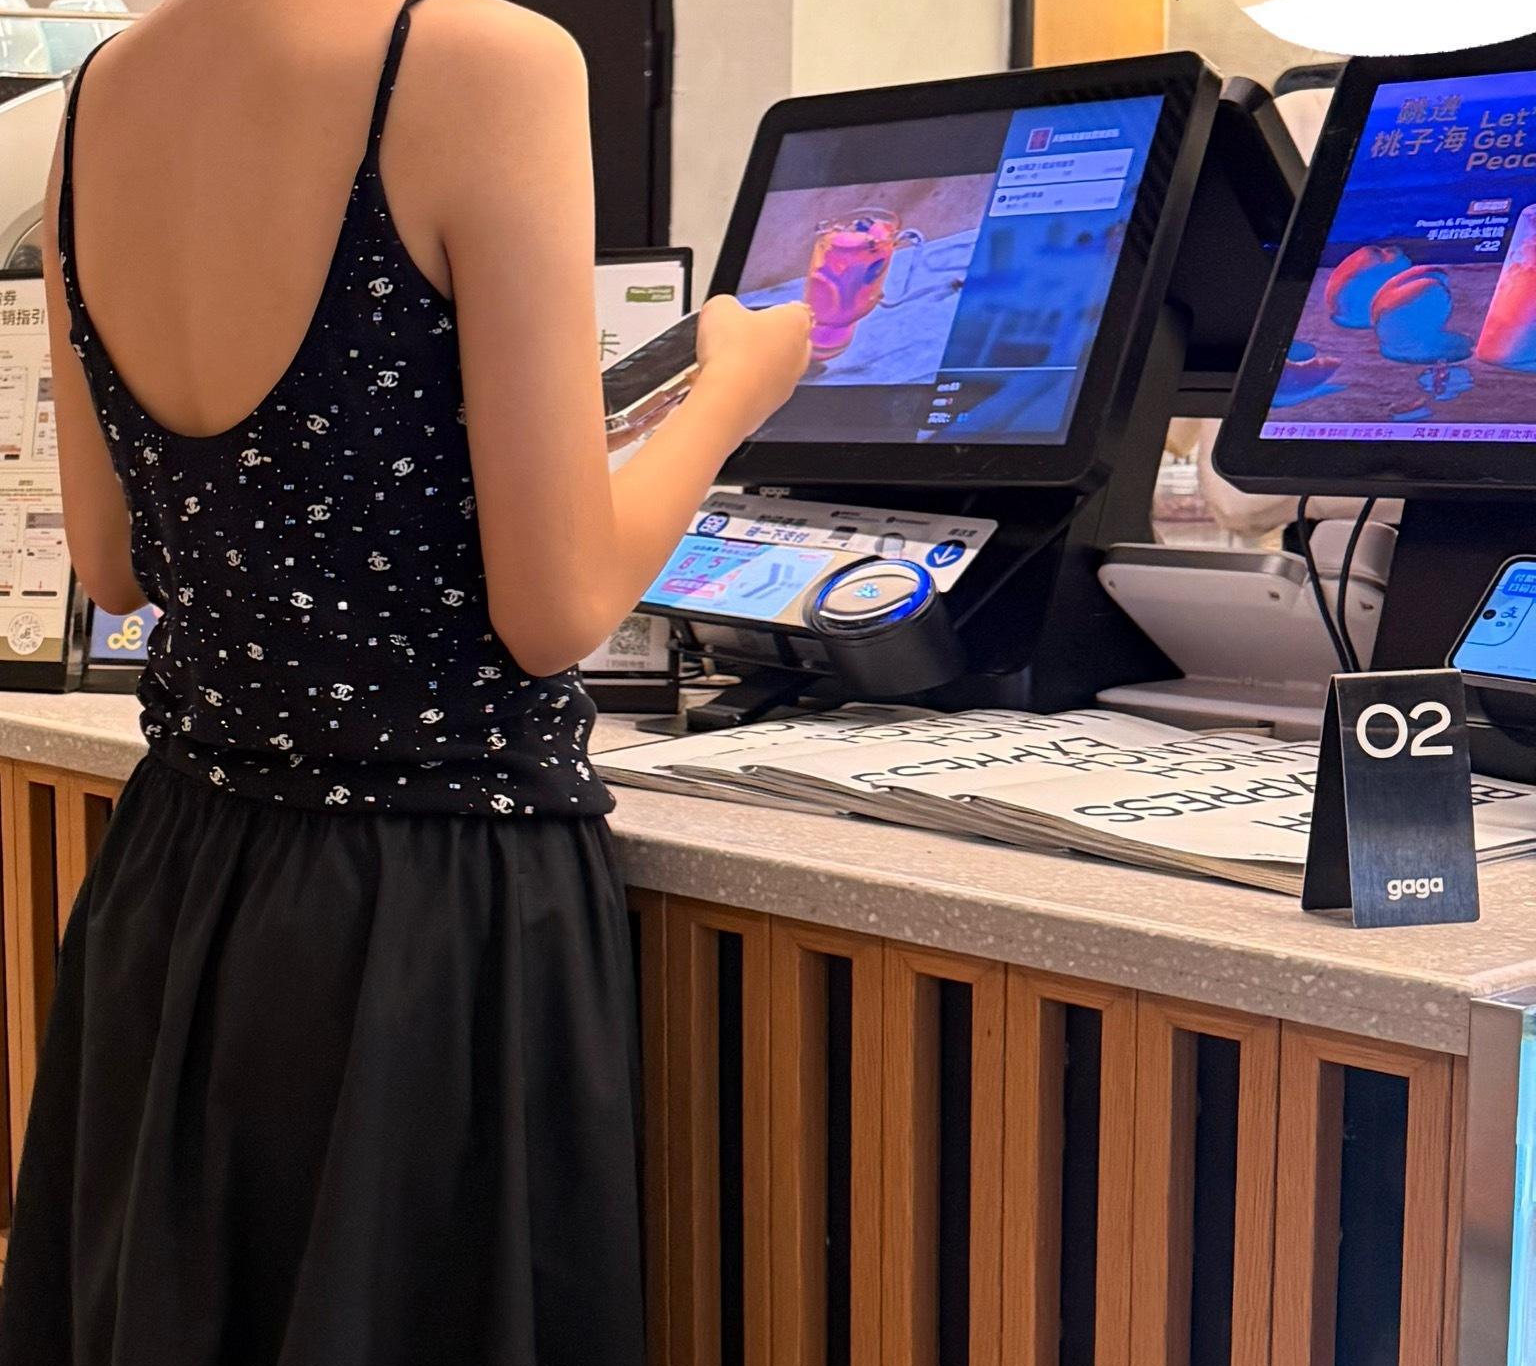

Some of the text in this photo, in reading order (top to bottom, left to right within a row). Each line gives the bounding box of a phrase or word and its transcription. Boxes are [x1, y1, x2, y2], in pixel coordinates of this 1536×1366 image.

[1370, 125, 1469, 158] 桃子海
[1474, 130, 1526, 150] Get
[1356, 702, 1453, 759] 02
[1041, 736, 1261, 771] LUNCH
[1073, 770, 1317, 823] XPRESS
[1387, 877, 1444, 901] gaga
